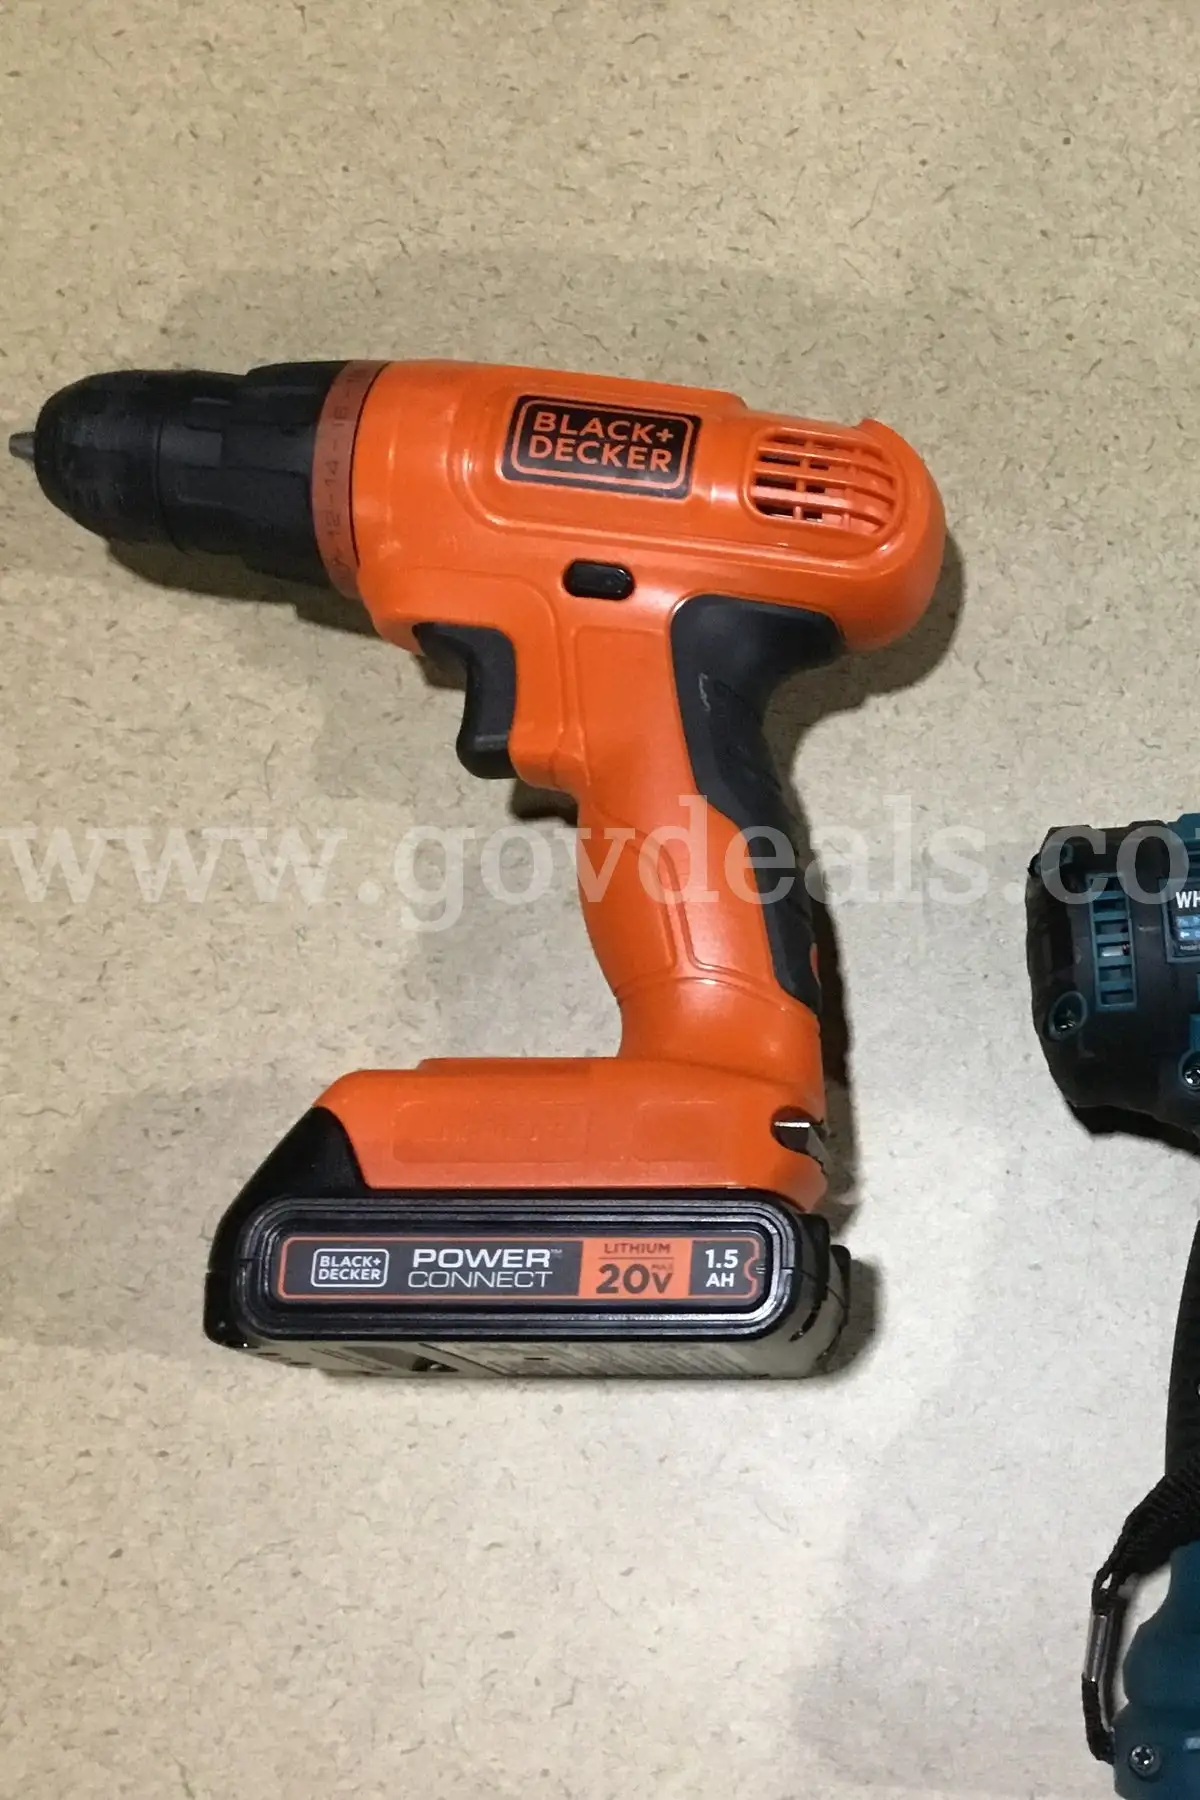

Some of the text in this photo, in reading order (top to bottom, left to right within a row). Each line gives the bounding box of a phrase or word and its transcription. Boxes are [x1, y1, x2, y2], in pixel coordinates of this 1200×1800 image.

[533, 411, 674, 444] BLACK+
[528, 435, 672, 473] DECKER
[324, 458, 340, 487] 14
[604, 1243, 671, 1254] LITHIUM
[319, 1255, 382, 1268] BLACK+
[705, 1248, 739, 1269] 1.5
[318, 1268, 381, 1281] DECKER
[408, 1271, 553, 1288] CONNECT
[705, 1272, 735, 1288] AH
